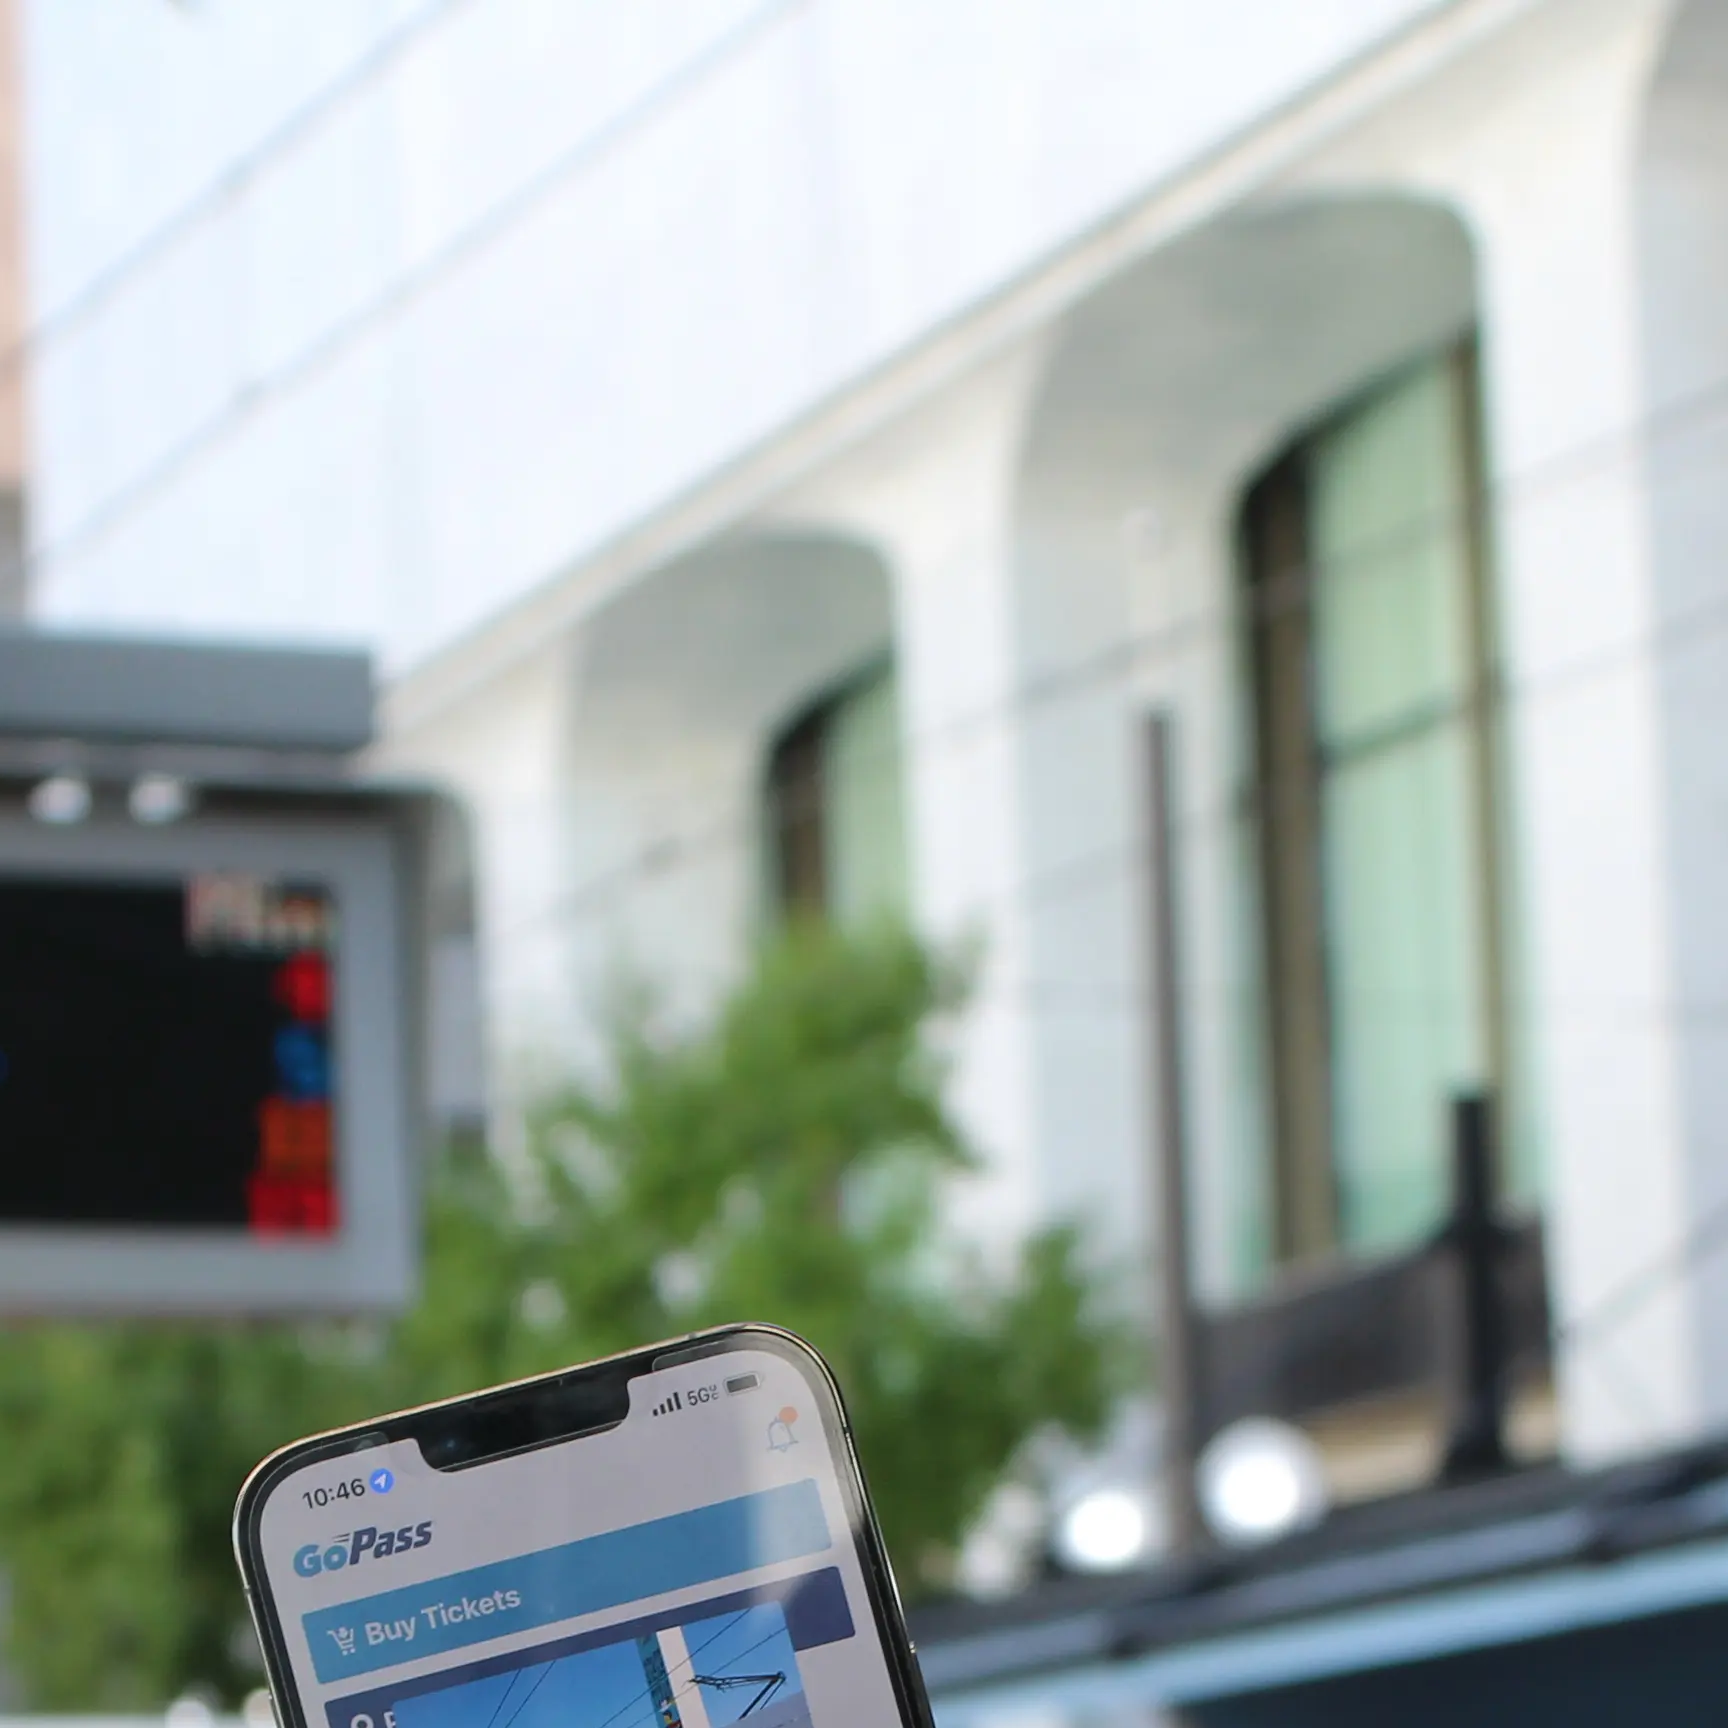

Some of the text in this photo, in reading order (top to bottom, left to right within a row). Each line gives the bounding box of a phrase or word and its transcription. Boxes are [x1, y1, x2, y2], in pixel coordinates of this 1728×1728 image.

[302, 1478, 365, 1509] 10:46
[293, 1520, 433, 1578] GoPass
[365, 1590, 521, 1646] Buy Tickets
